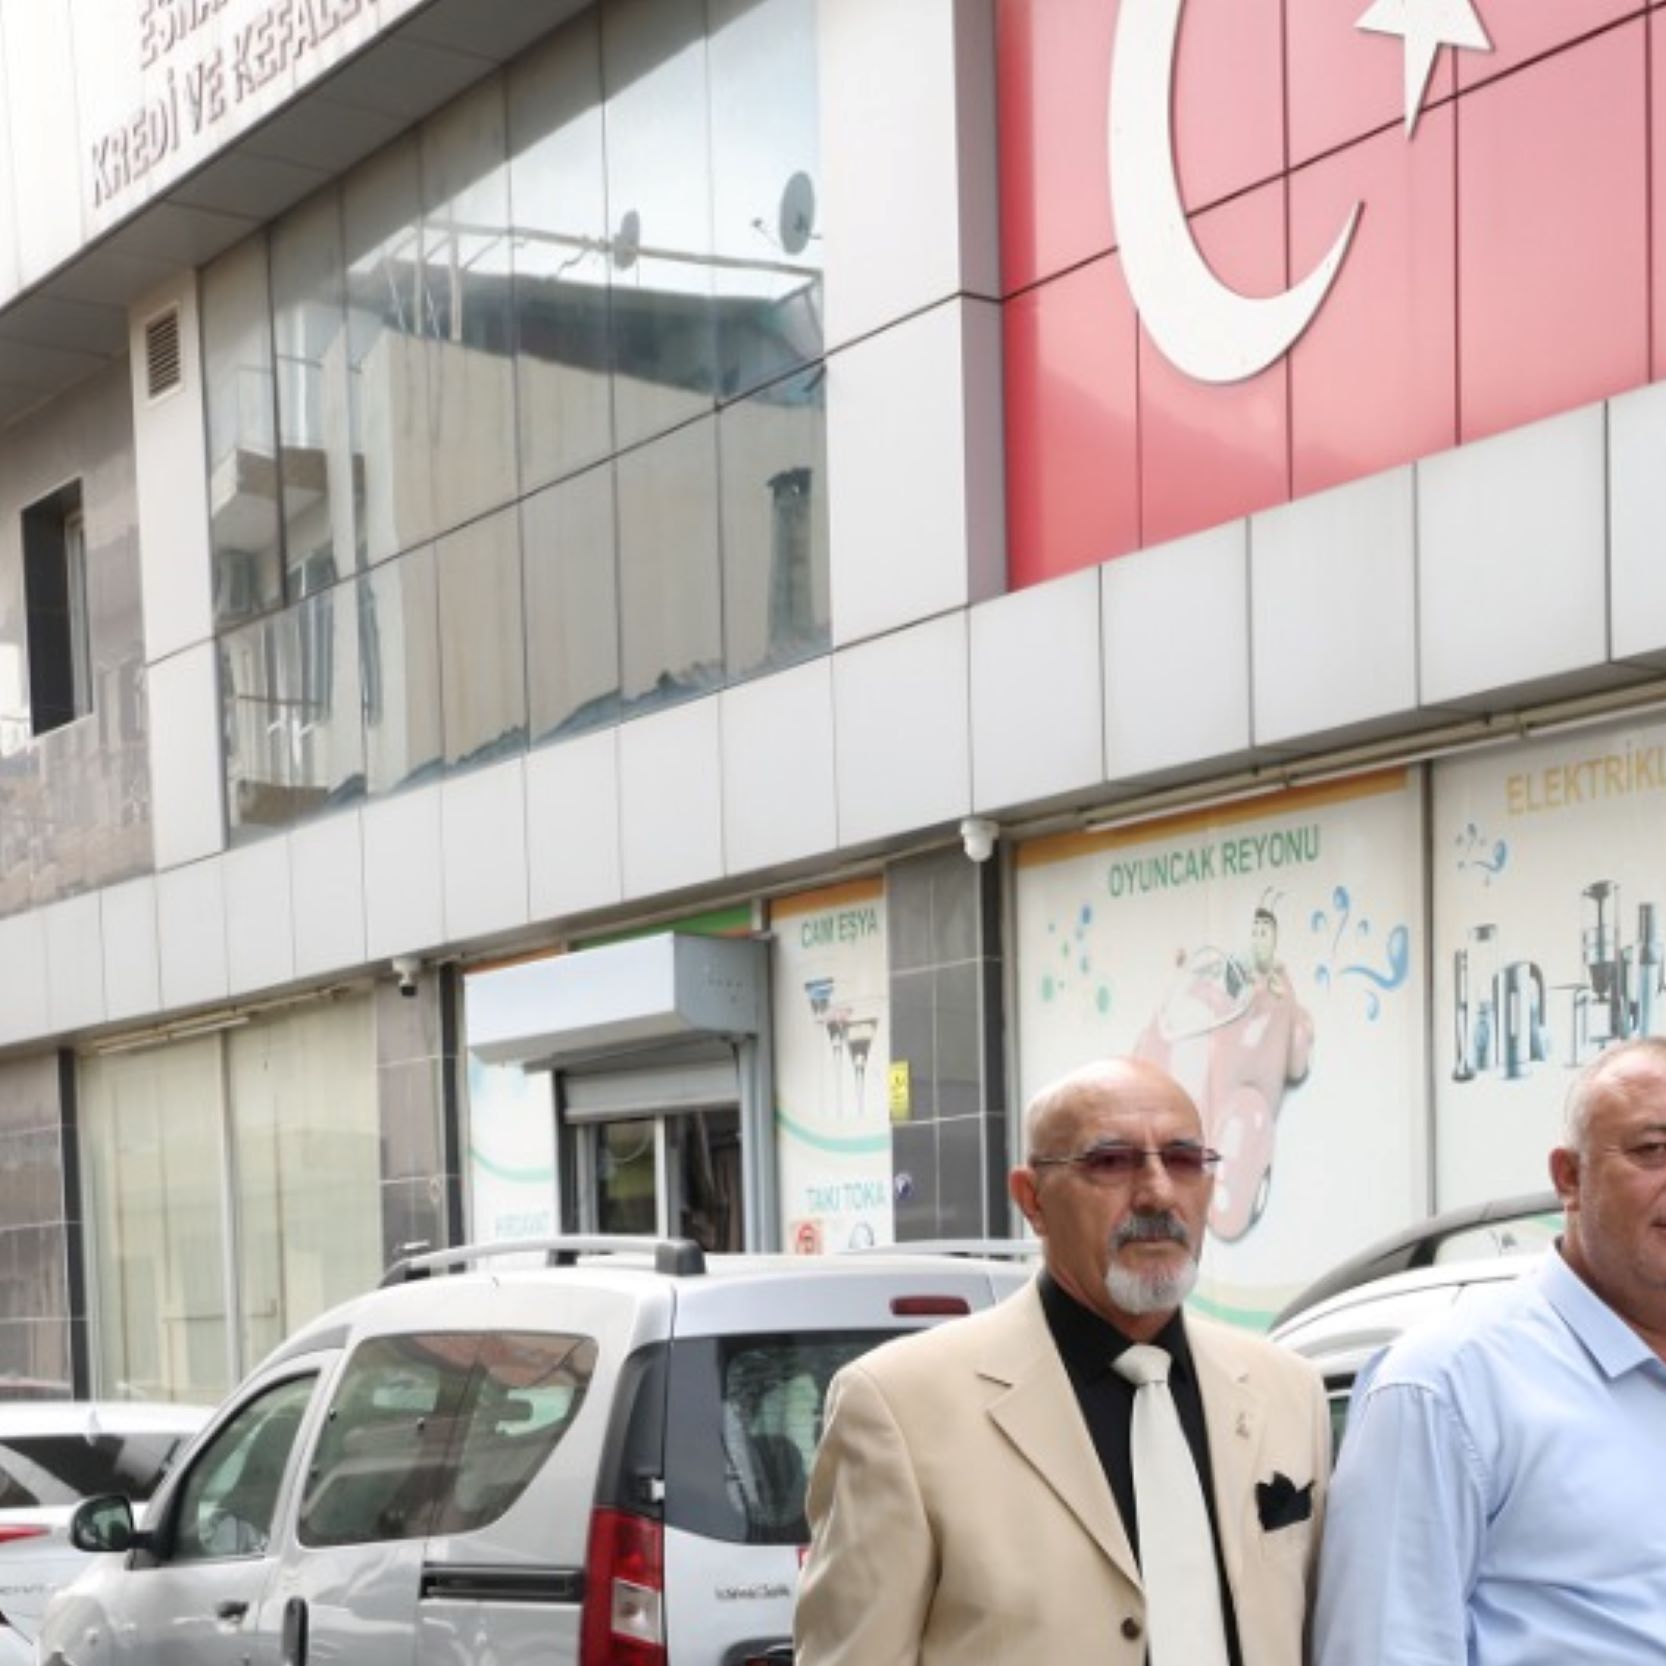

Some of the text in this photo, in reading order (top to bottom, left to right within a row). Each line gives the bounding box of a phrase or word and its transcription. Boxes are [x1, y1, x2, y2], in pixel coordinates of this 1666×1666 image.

[92, 67, 181, 208] KREDİ
[186, 48, 226, 134] VE
[1108, 824, 1319, 897] OYUNCAK REYONU
